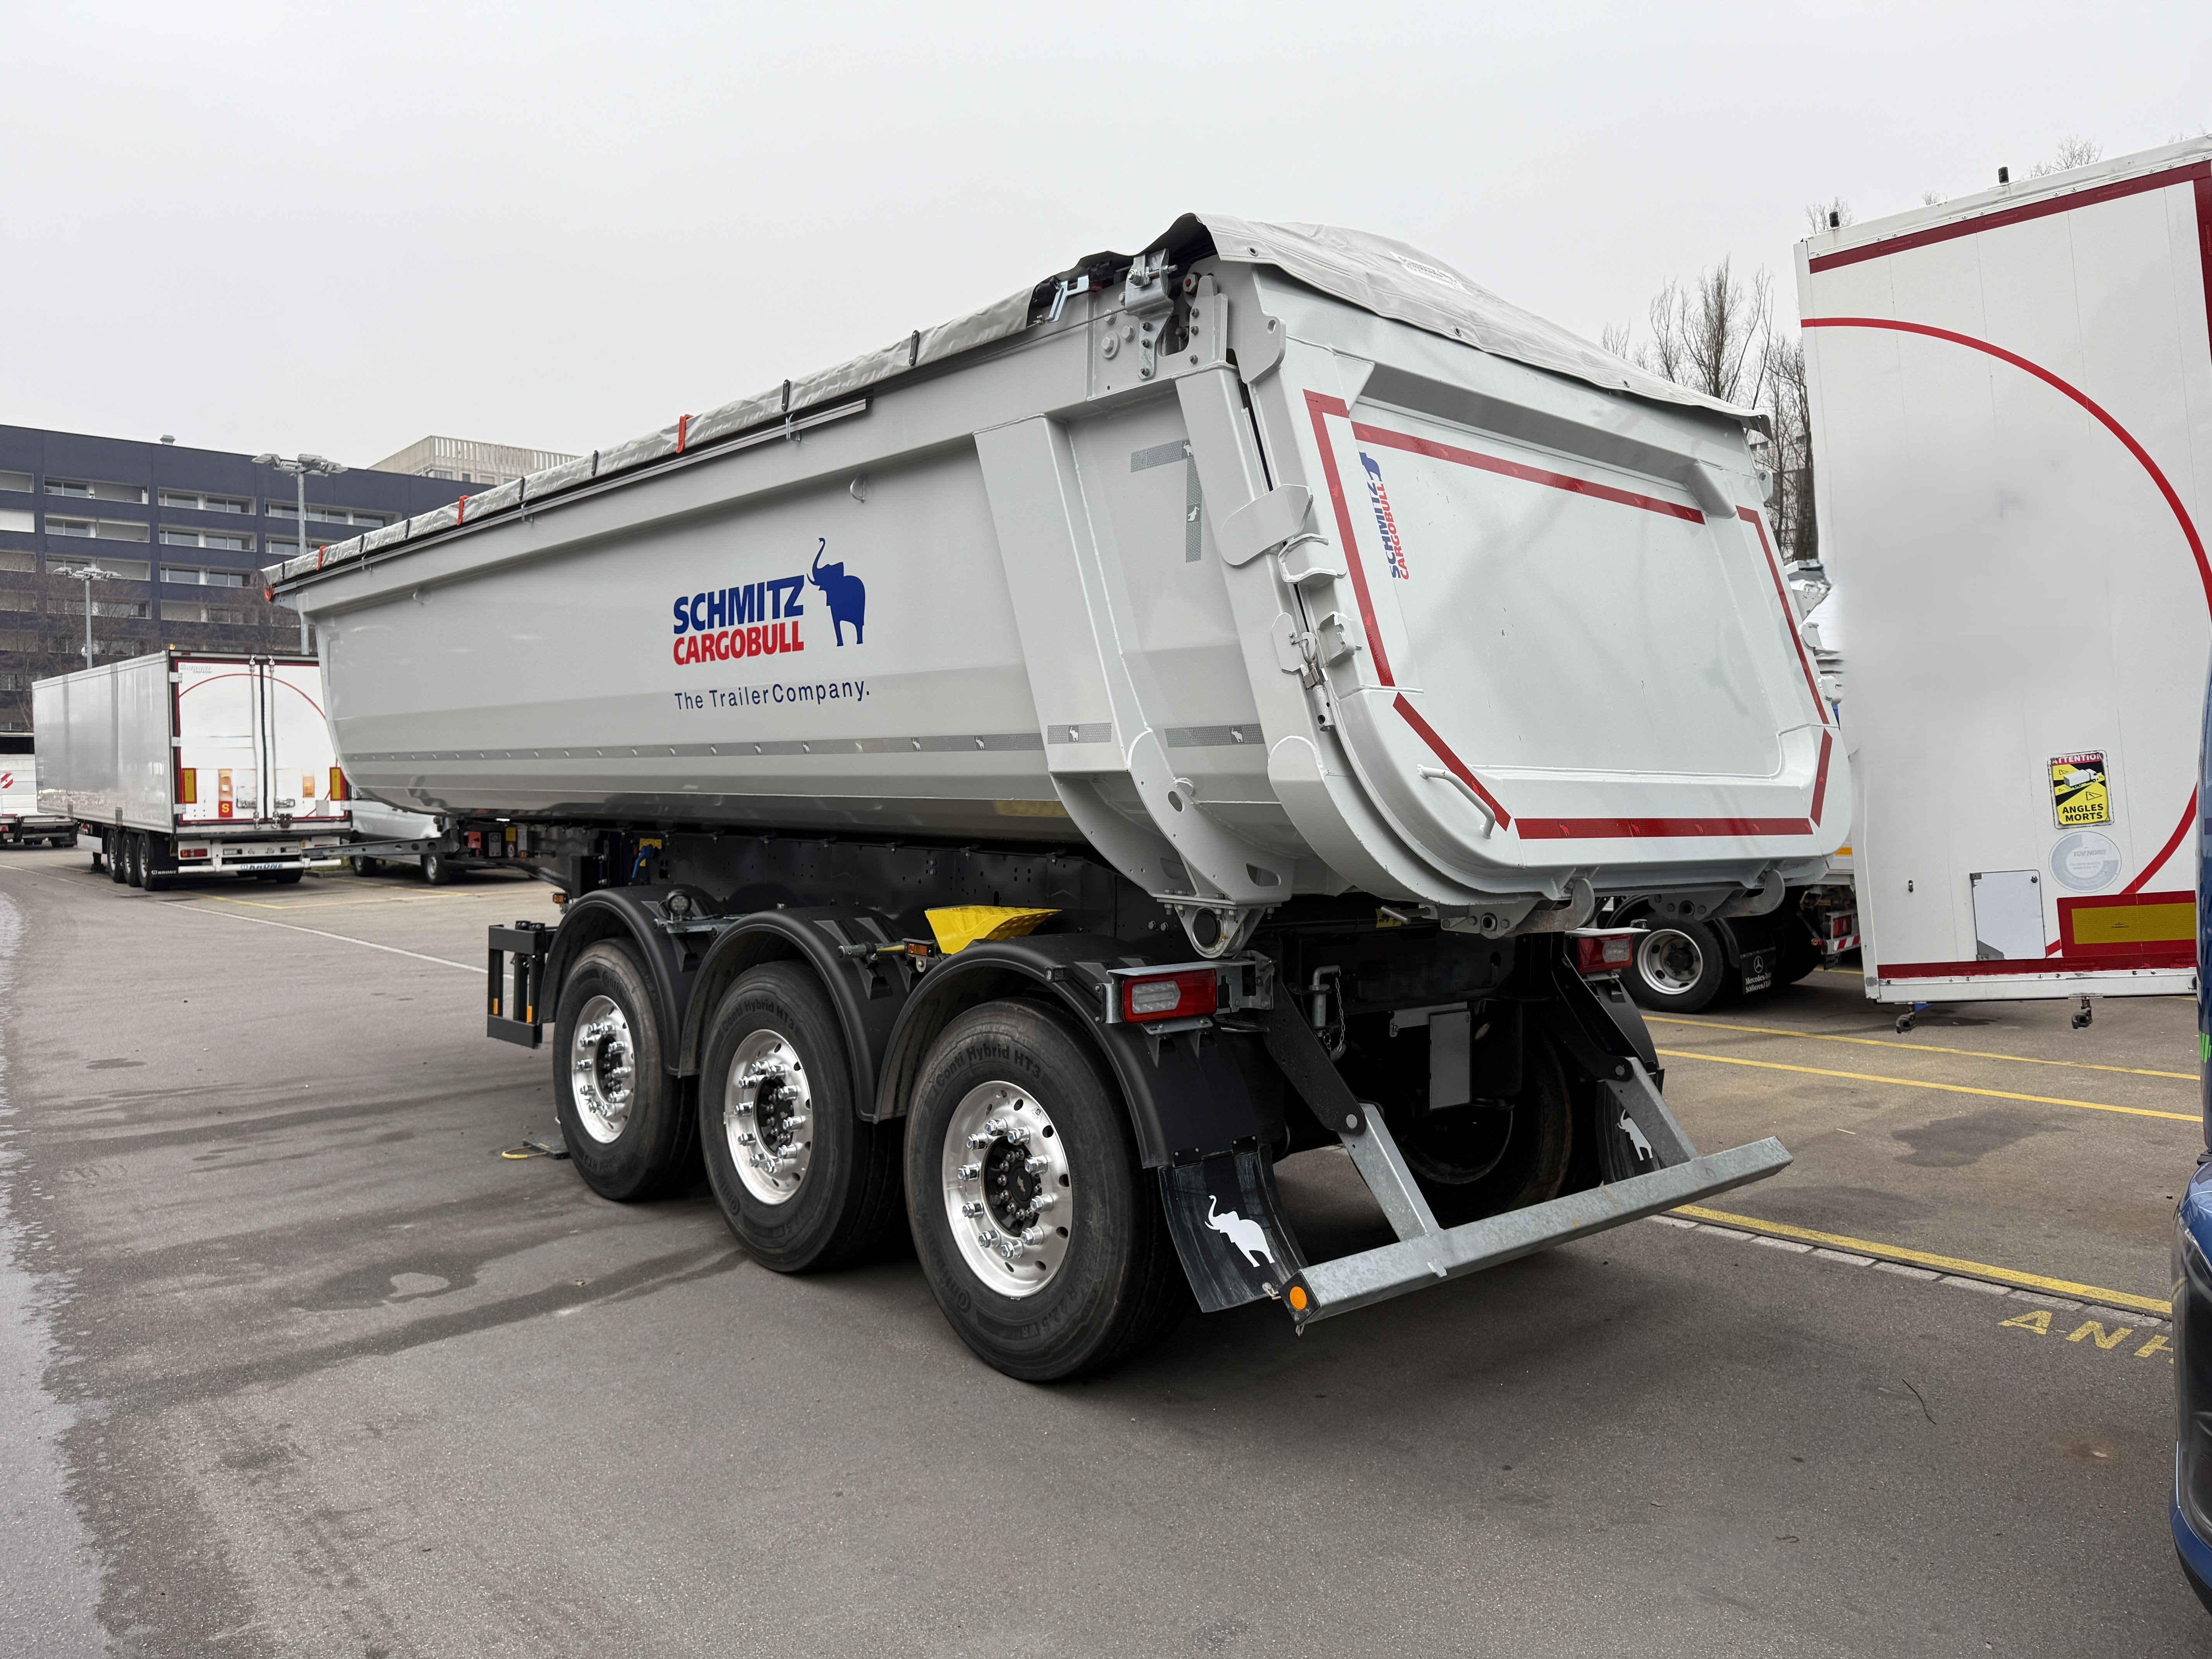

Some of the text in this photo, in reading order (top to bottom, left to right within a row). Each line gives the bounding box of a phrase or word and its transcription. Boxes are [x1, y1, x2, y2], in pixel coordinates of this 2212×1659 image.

[1367, 481, 1401, 579] SCHMITZ
[1377, 483, 1409, 580] CARGOBULL
[673, 575, 805, 634] SCHMITZ
[673, 620, 804, 666] CARGOBULL
[675, 692, 703, 709] The
[222, 803, 230, 813] S
[2063, 804, 2104, 814] ANGLES
[2065, 812, 2103, 822] MORTS
[1745, 972, 1771, 986] Mercedes-B
[1745, 979, 1771, 993] Schlieren/Z
[722, 998, 794, 1032] Conti Hybrid HT3
[936, 1043, 1041, 1087] Conti Hybrid HT3
